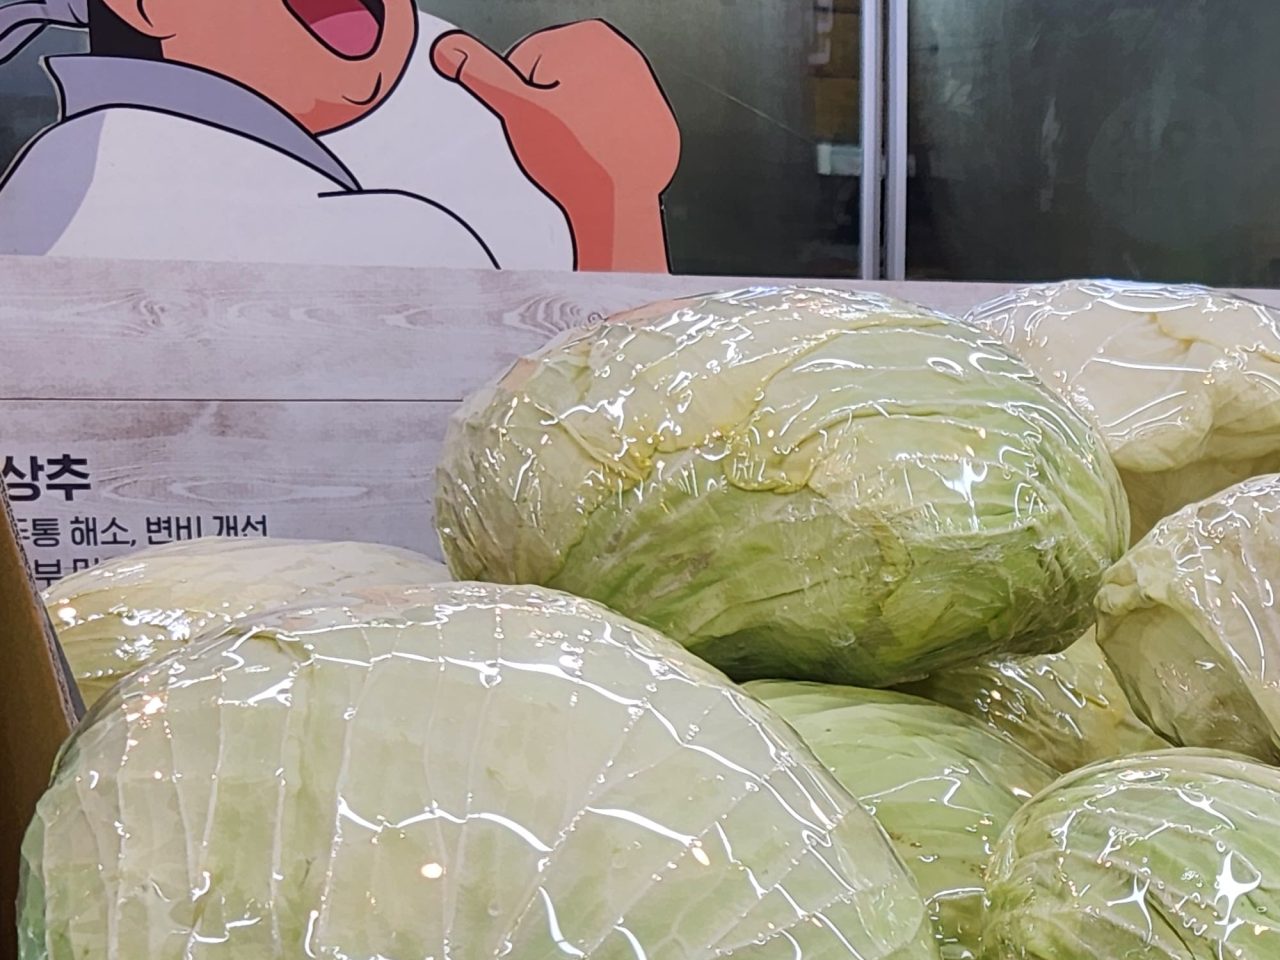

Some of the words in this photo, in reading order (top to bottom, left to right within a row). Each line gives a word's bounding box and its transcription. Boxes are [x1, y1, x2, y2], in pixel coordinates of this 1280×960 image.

[1, 453, 92, 502] 상추
[70, 515, 136, 548] 해소,
[146, 515, 202, 545] 변비
